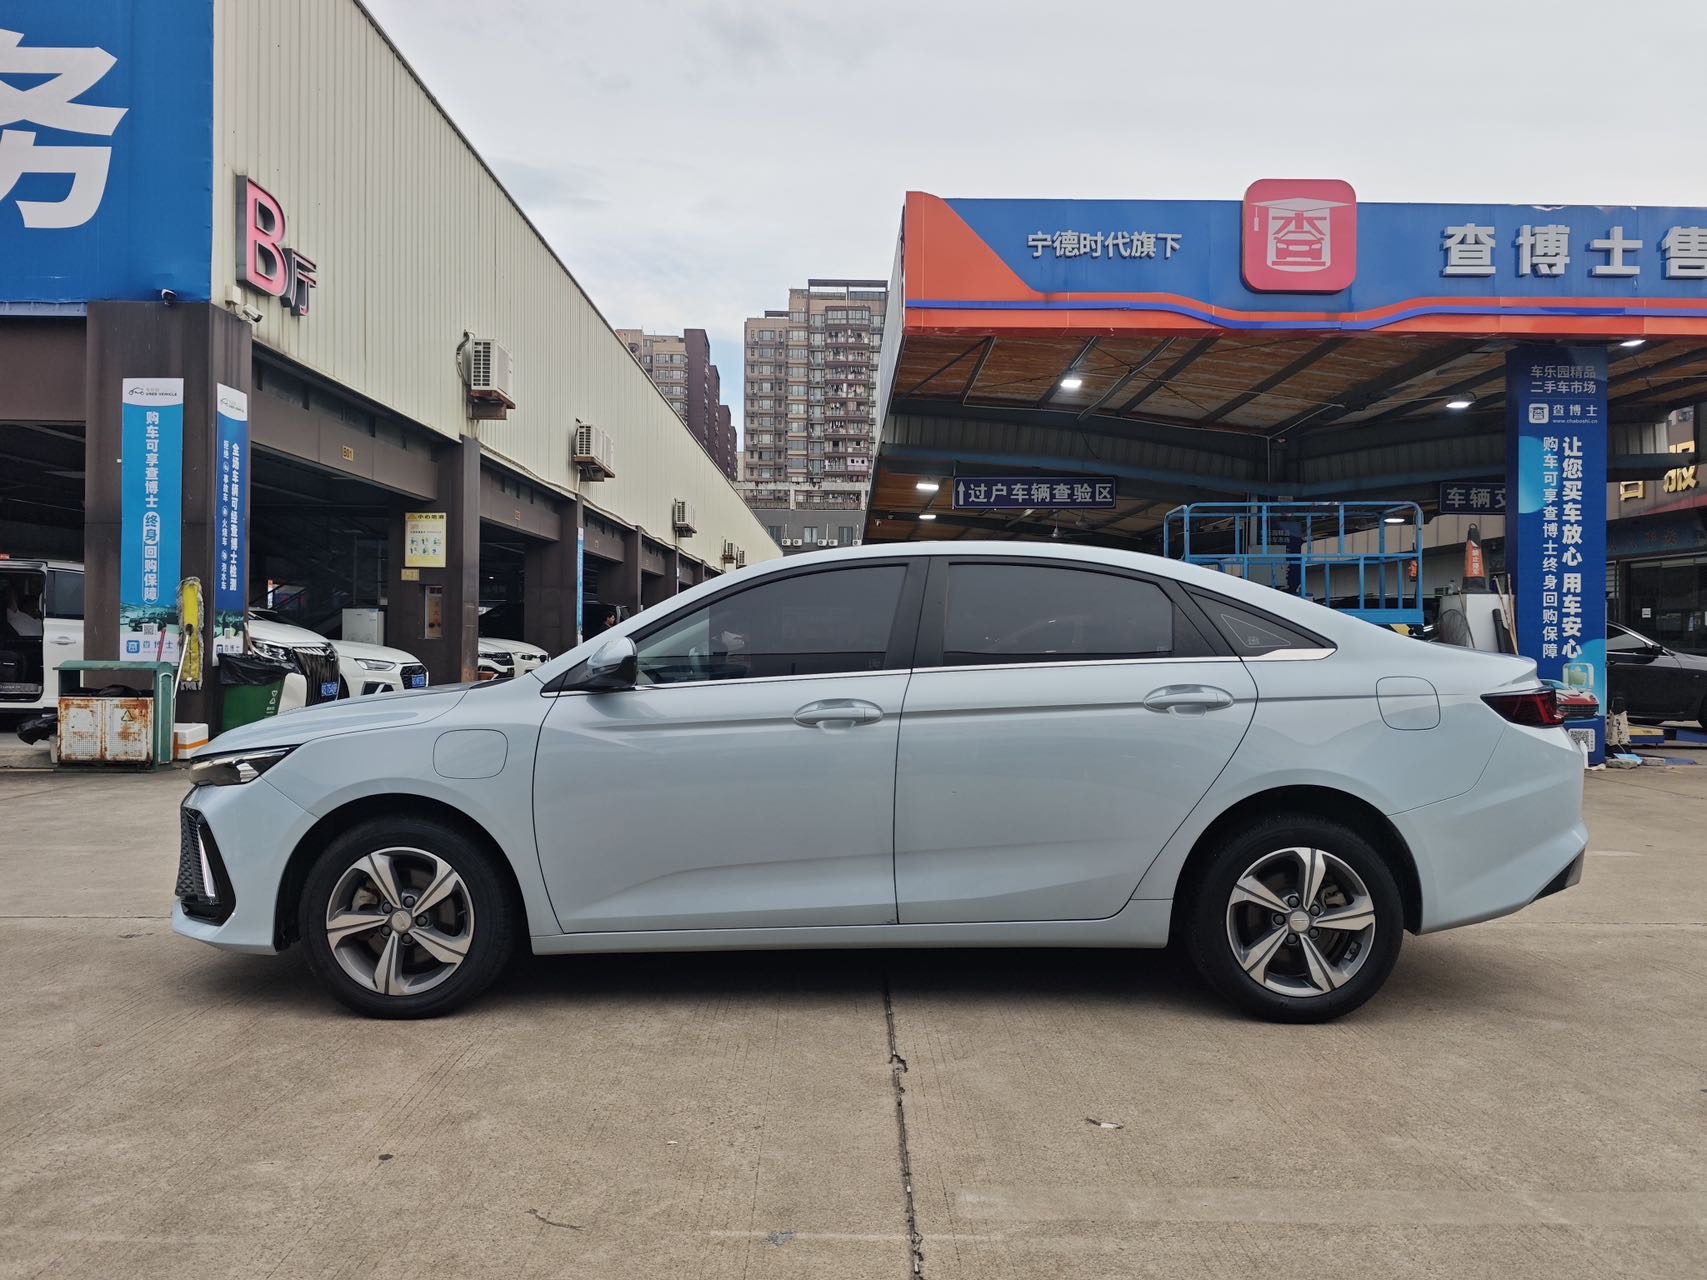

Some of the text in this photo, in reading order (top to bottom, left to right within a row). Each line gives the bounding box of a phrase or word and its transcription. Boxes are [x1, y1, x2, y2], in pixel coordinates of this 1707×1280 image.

[1027, 230, 1183, 258] 宁德时代旗下
[1530, 365, 1596, 378] 车乐园精品
[1530, 381, 1596, 393] 二手车市场
[1552, 404, 1598, 416] 查博士
[145, 411, 160, 508] 购车可享查博士
[968, 483, 1113, 503] 过户车辆查验区
[144, 515, 159, 601] 终身回购保障
[1542, 436, 1559, 659] 购车可享查博士终身回购保障
[1562, 436, 1583, 659] 让您买车放心 用车安心
